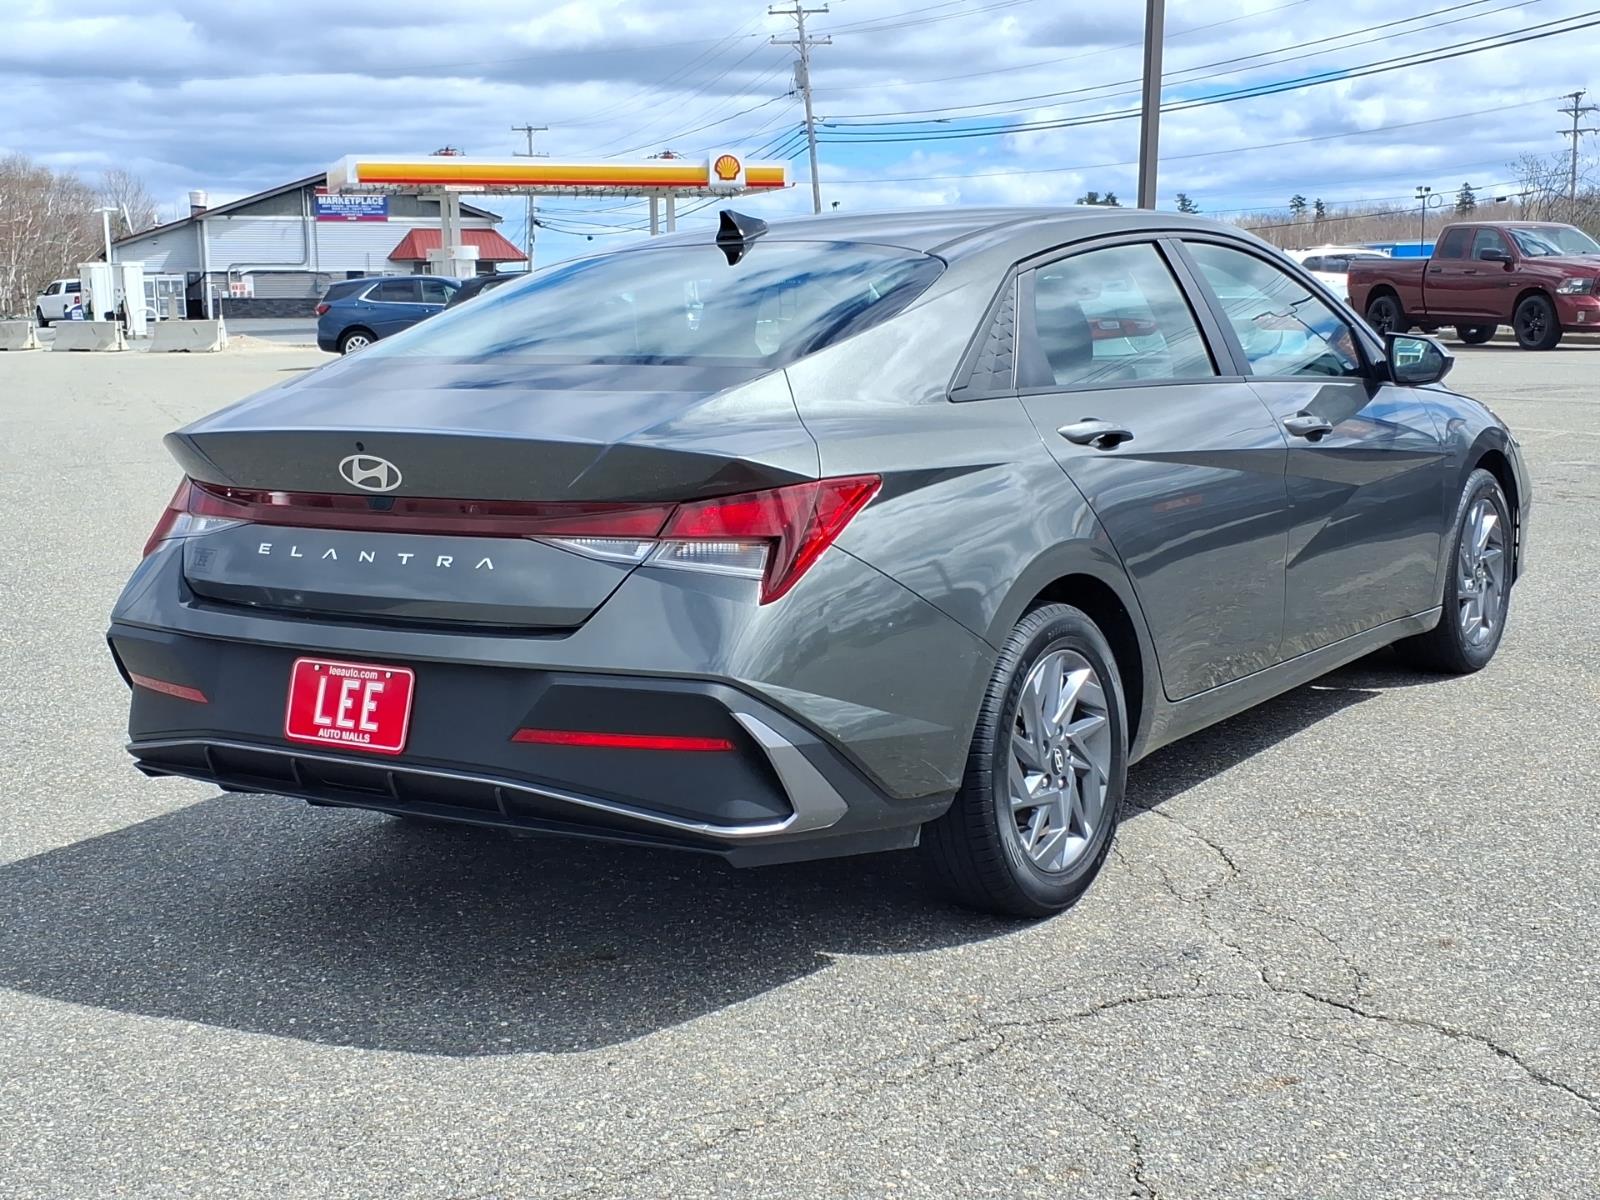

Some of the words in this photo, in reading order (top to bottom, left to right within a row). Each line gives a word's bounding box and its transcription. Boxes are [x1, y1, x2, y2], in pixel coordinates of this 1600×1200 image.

[258, 543, 494, 571] ELANTRA
[329, 666, 378, 679] leeauto.com
[313, 676, 385, 732] LEE
[318, 728, 341, 739] AUTO
[342, 731, 370, 743] MALLS
